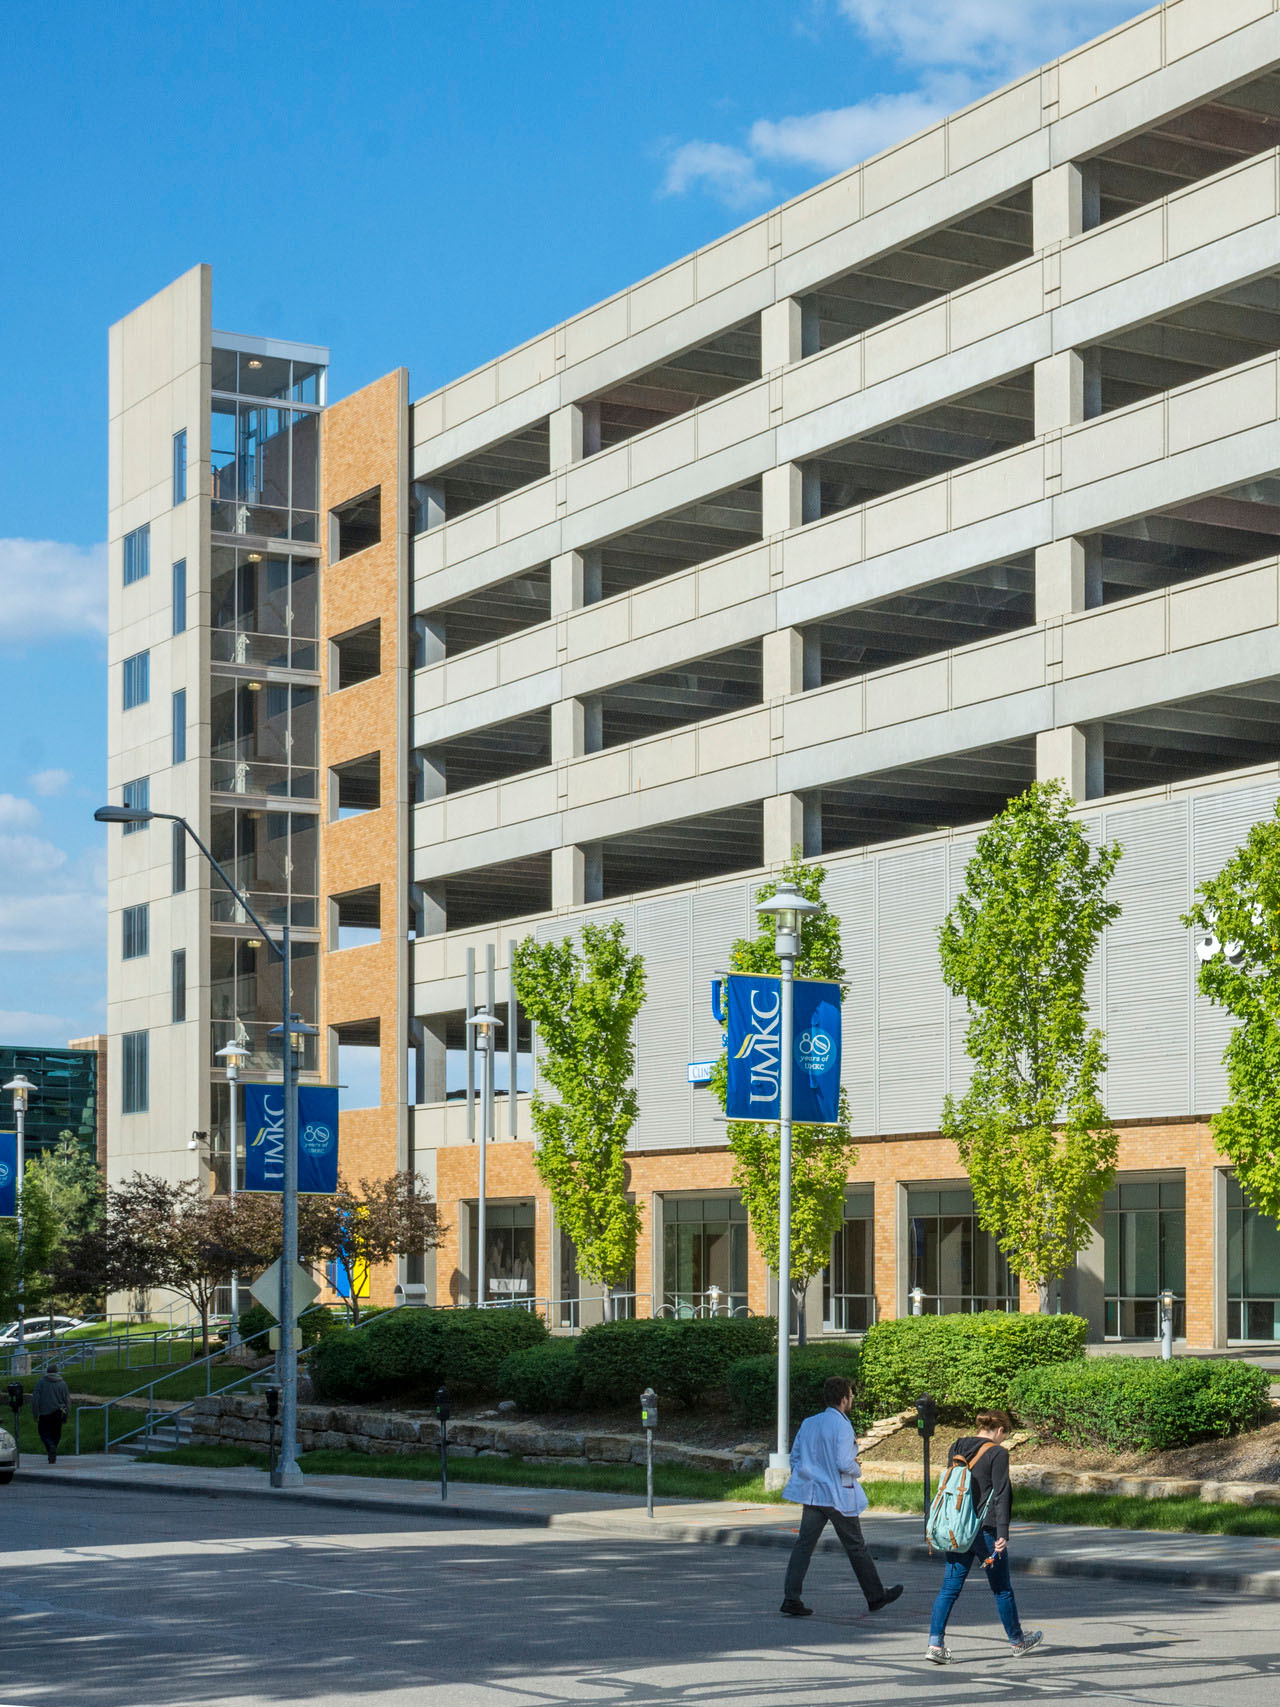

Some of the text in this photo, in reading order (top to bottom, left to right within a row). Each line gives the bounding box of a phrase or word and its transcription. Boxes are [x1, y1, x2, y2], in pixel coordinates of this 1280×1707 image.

[743, 989, 780, 1105] UMKC
[799, 1032, 831, 1056] 80
[303, 1125, 330, 1143] 80
